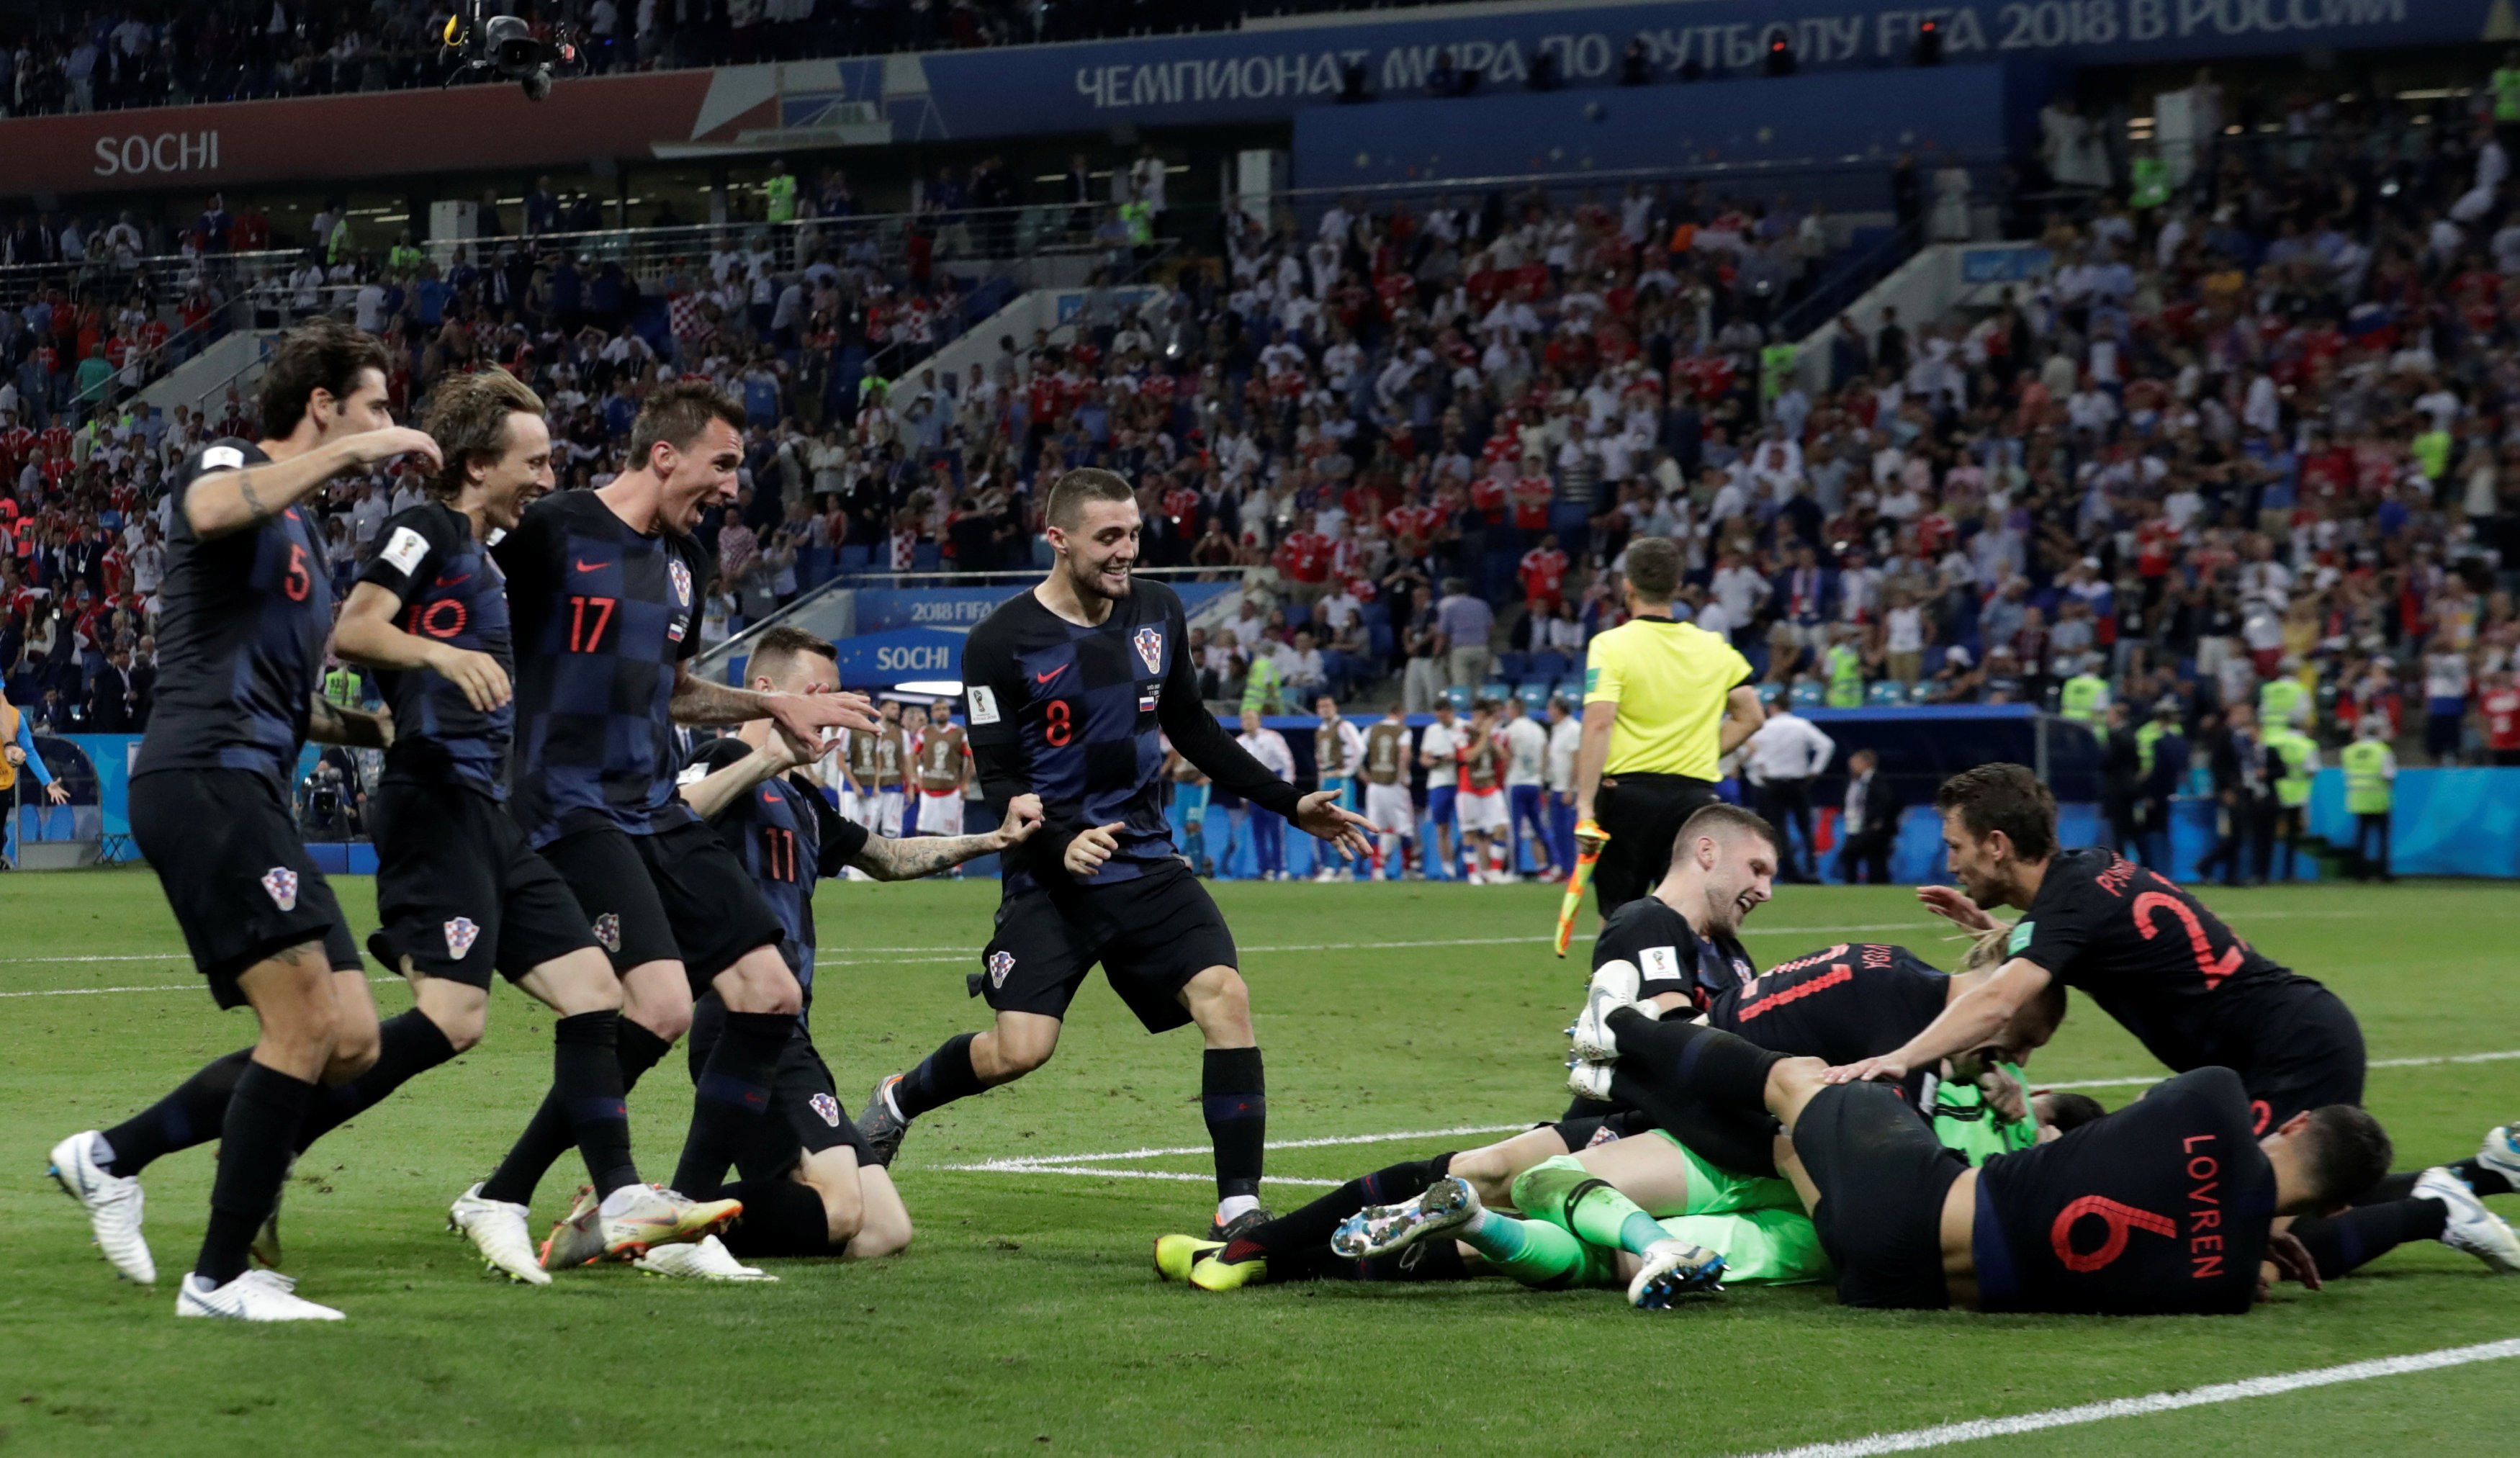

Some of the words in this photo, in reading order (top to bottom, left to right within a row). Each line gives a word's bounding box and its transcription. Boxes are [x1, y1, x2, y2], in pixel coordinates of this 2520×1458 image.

[1997, 1, 2121, 50] 2018
[2128, 0, 2168, 41] В
[94, 130, 219, 176] SOCHI
[283, 543, 311, 602] 5
[407, 598, 467, 638] 10
[570, 596, 616, 653] 17
[910, 602, 953, 621] 2018
[876, 646, 949, 670] SOCHI
[1046, 698, 1071, 746] 8
[765, 827, 795, 883] 11
[2182, 1134, 2226, 1279] LOVREN
[2051, 1194, 2177, 1274] 6
